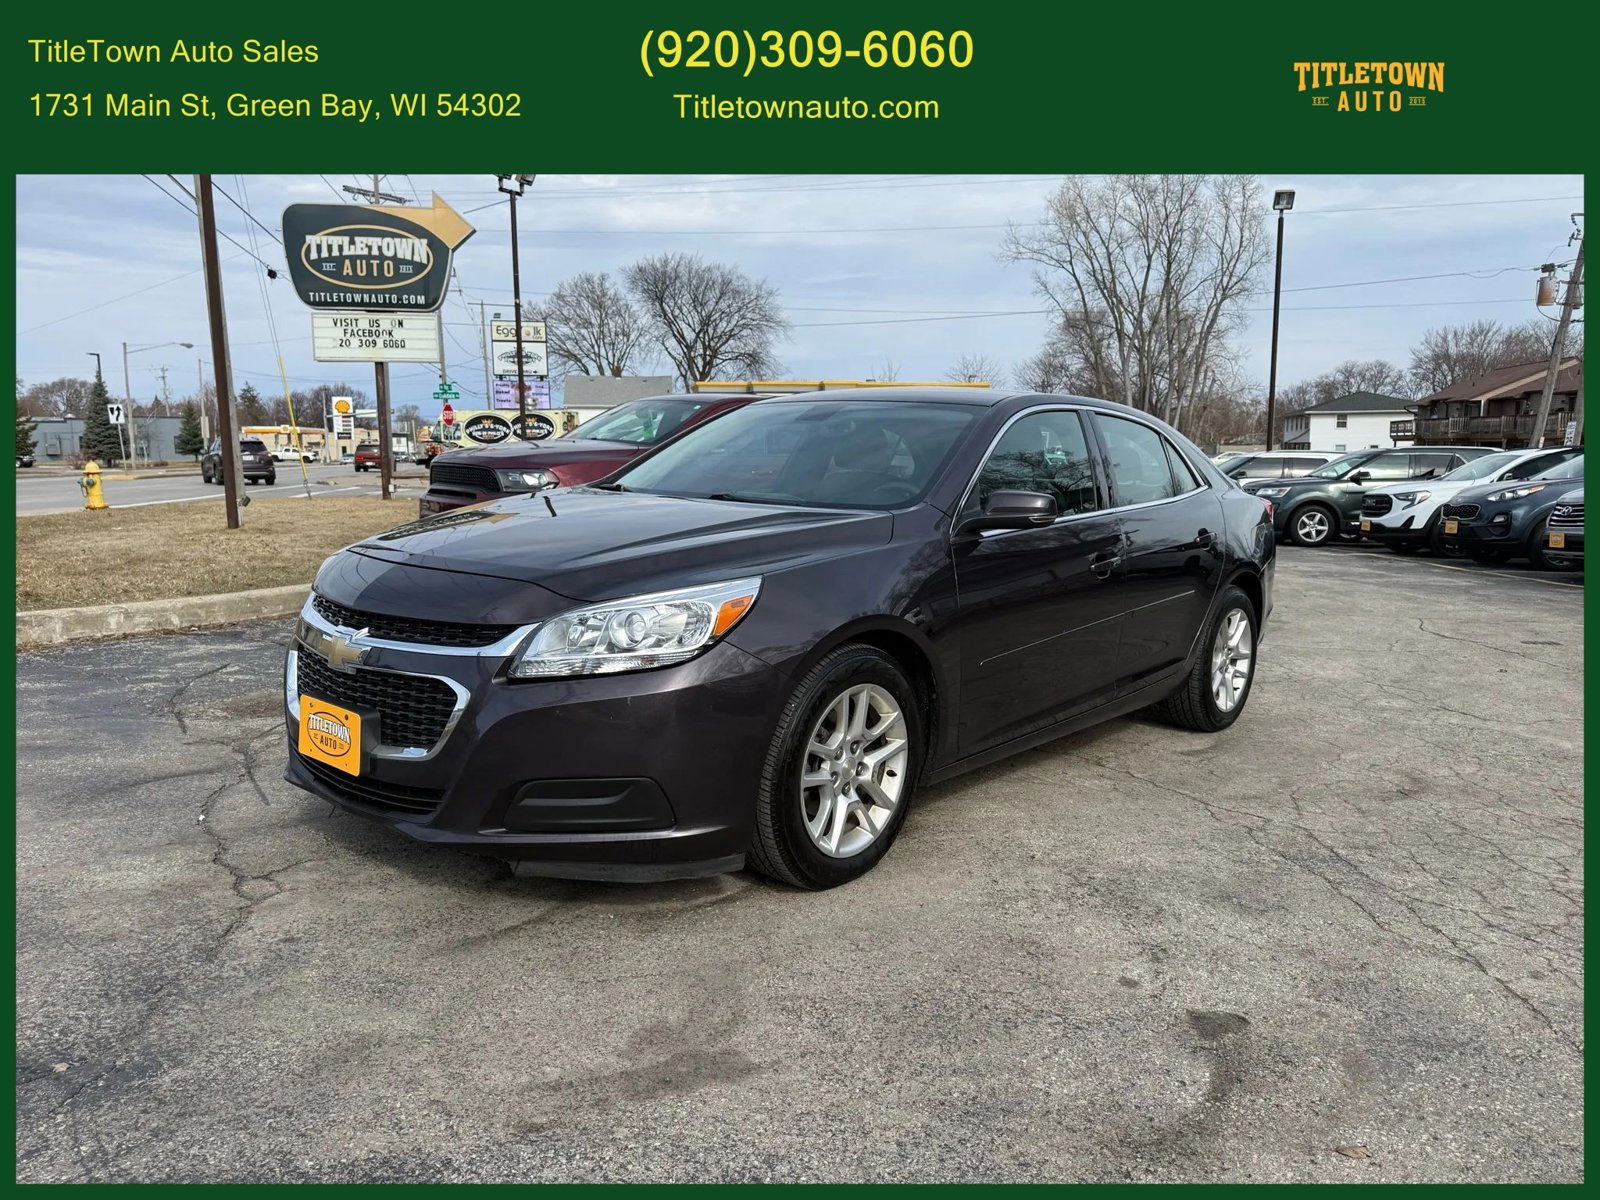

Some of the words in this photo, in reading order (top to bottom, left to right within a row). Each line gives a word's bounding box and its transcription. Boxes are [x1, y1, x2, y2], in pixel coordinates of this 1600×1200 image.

[305, 234, 428, 264] TITLETOWN
[342, 259, 394, 277] AUTO
[308, 291, 426, 305] TITLETOWNAUTO.COM
[332, 318, 359, 328] VISIT
[368, 319, 380, 328] US
[391, 319, 404, 328] ON
[343, 328, 394, 338] FACEBOOK
[358, 339, 377, 348] 309
[383, 339, 406, 349] 6060
[443, 410, 454, 420] STOP
[308, 714, 350, 745] TITLETOWN
[320, 735, 337, 750] AUTO
